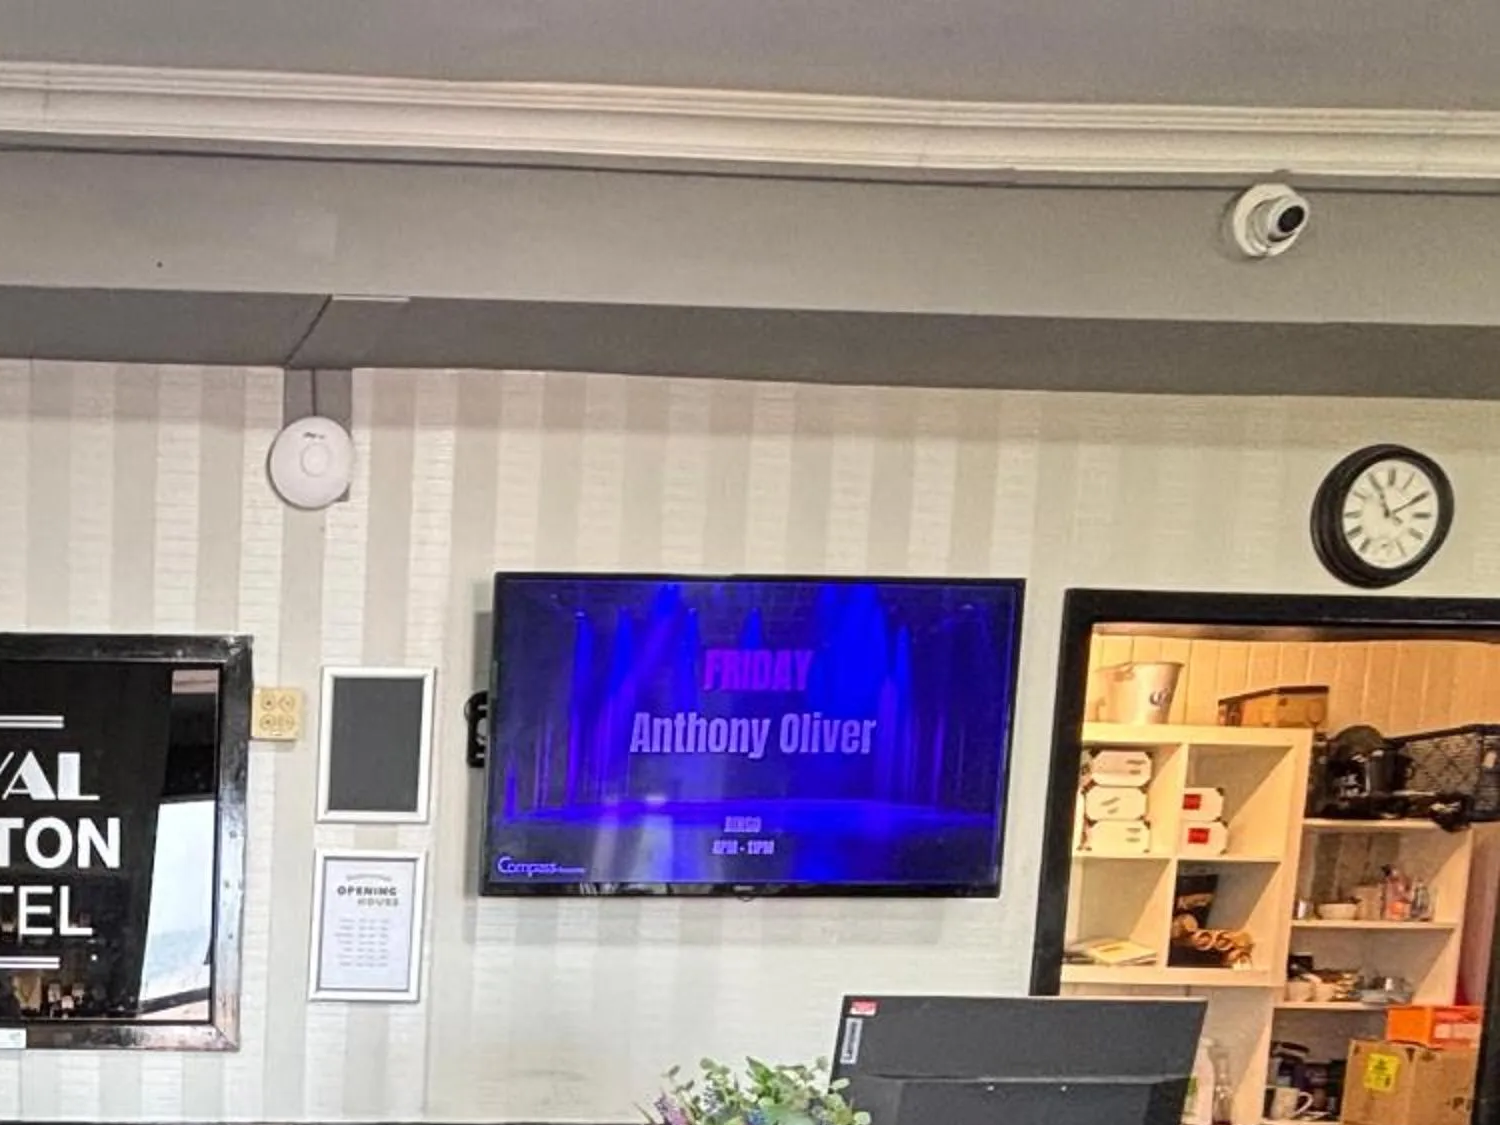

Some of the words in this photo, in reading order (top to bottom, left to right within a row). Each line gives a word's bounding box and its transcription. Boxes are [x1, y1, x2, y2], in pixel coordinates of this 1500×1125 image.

[704, 649, 813, 691] FRIDAY
[629, 712, 771, 759] Anthony
[779, 712, 877, 755] Oliver
[337, 885, 397, 897] OPENING
